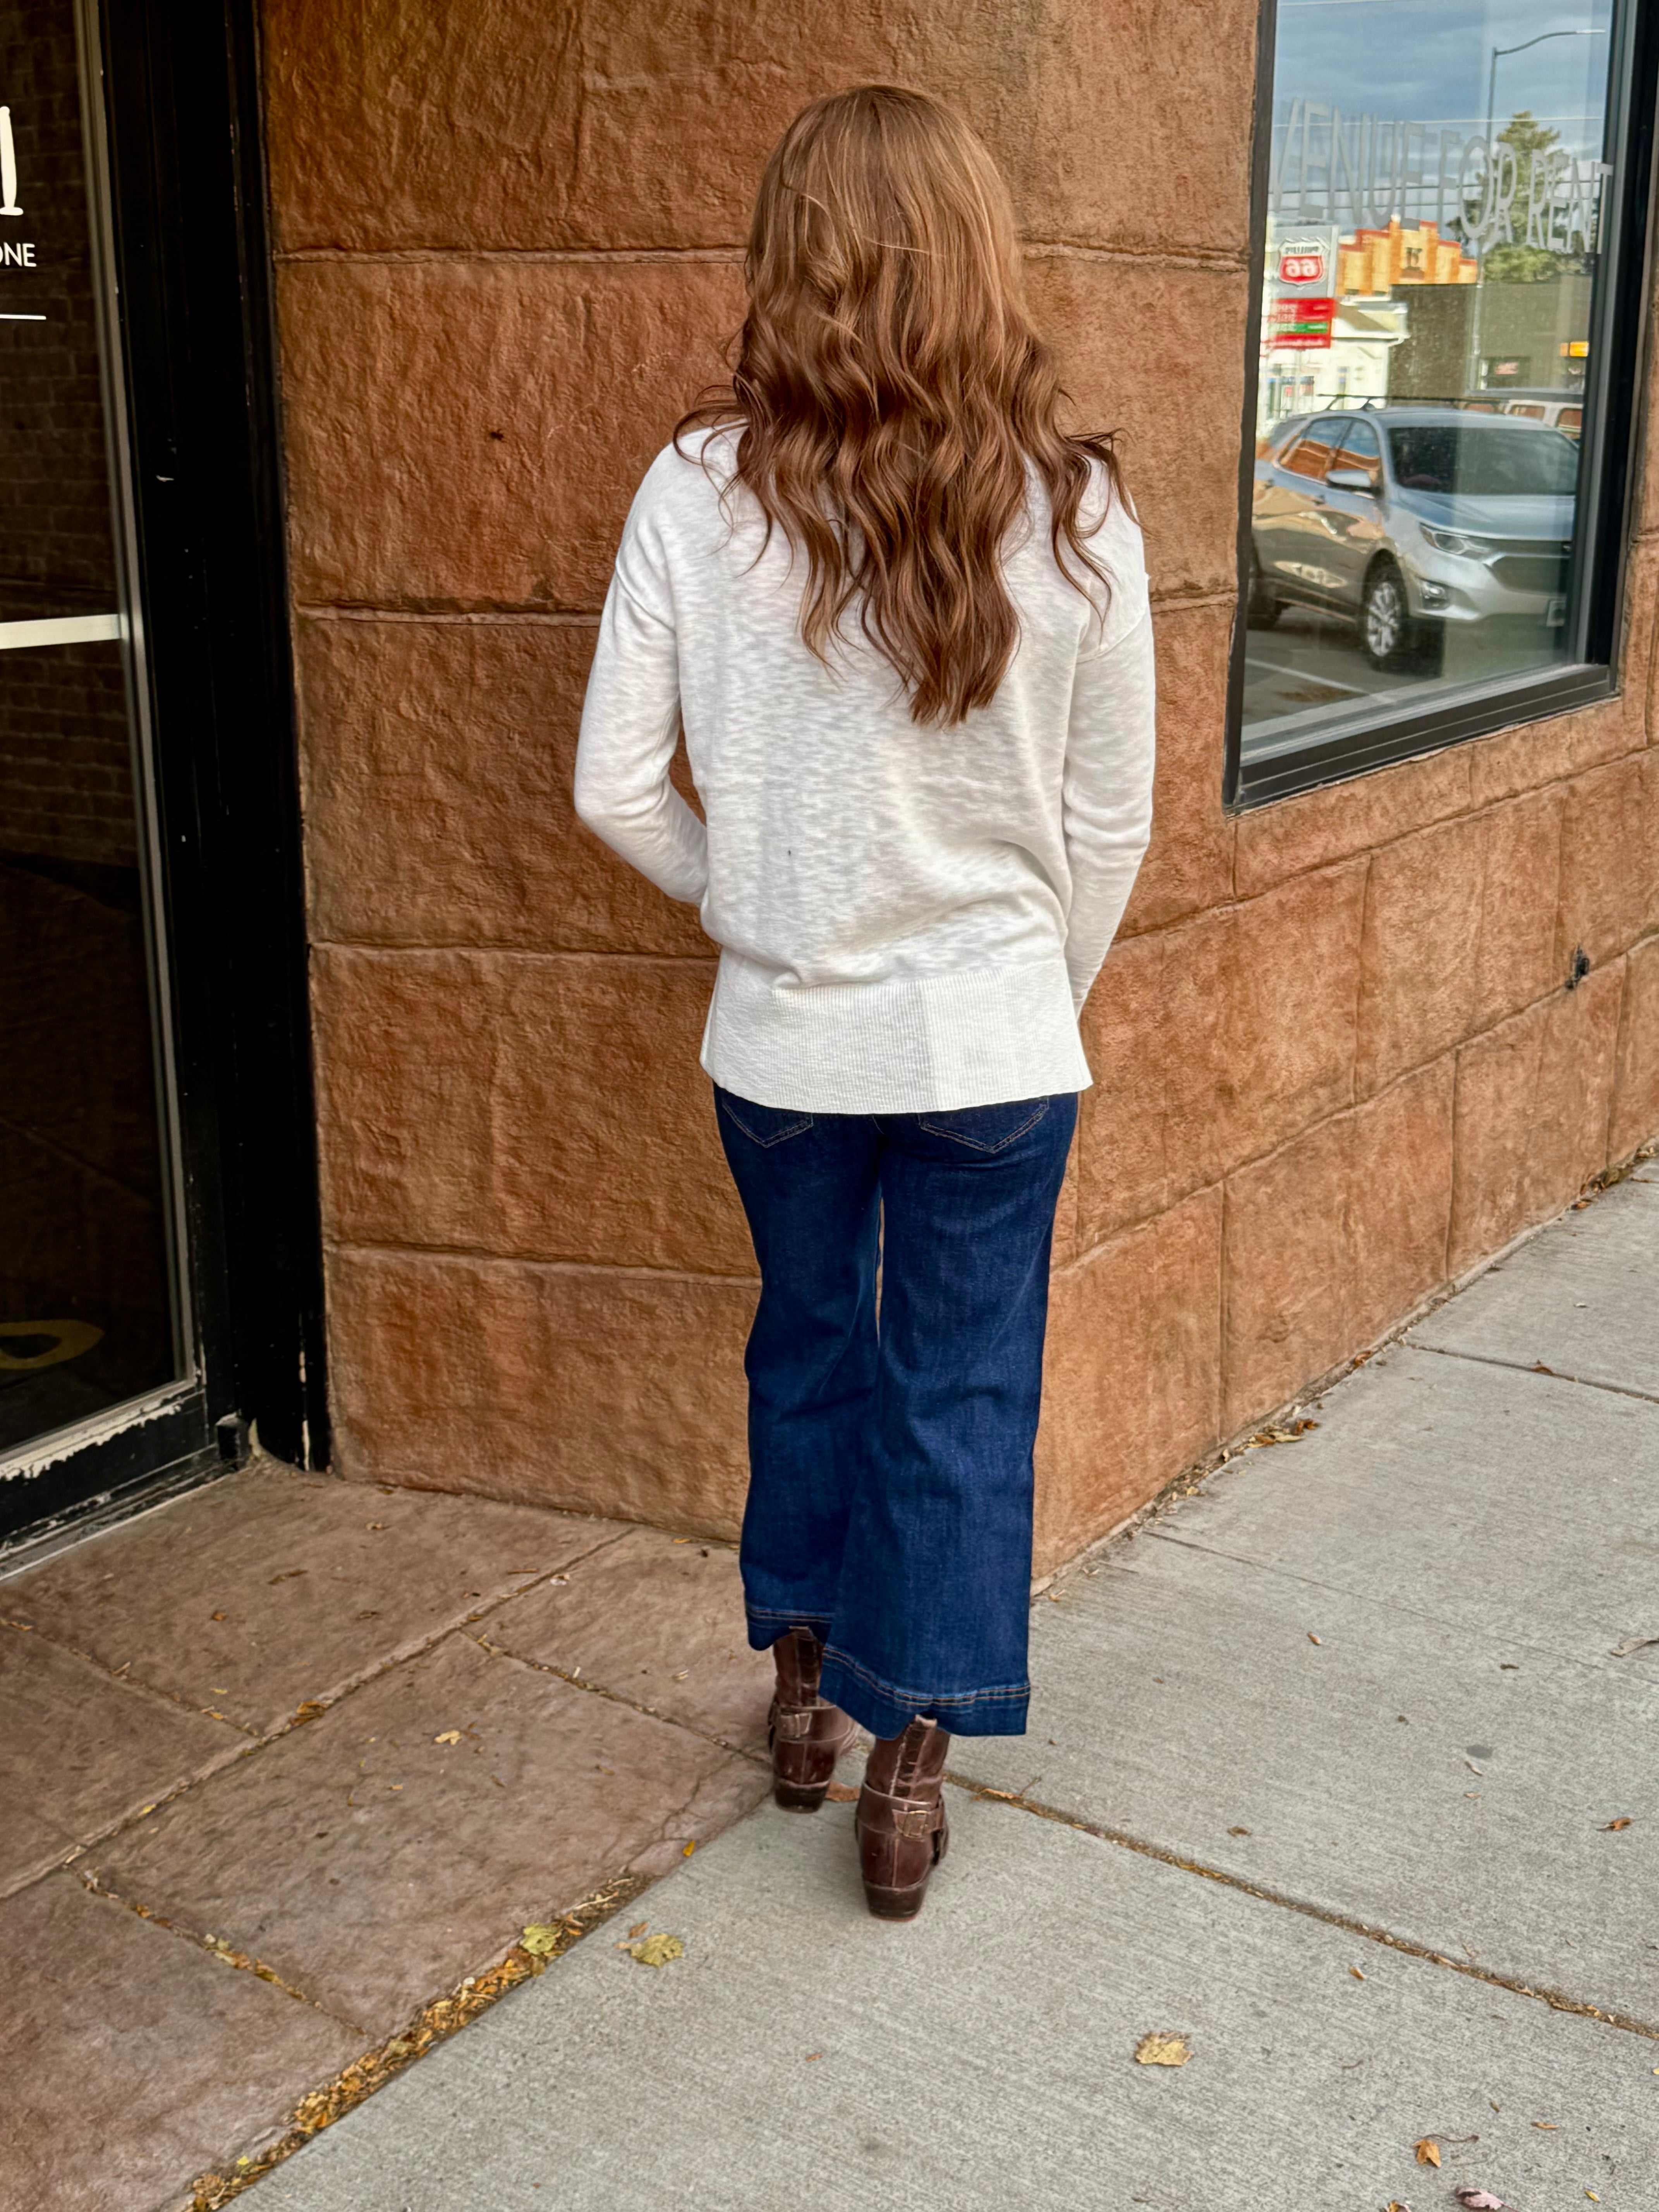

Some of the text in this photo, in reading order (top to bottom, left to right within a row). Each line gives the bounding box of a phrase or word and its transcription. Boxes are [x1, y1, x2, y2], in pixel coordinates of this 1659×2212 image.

[1271, 98, 1614, 254] VENUE FOR RENT
[0, 242, 37, 267] NE
